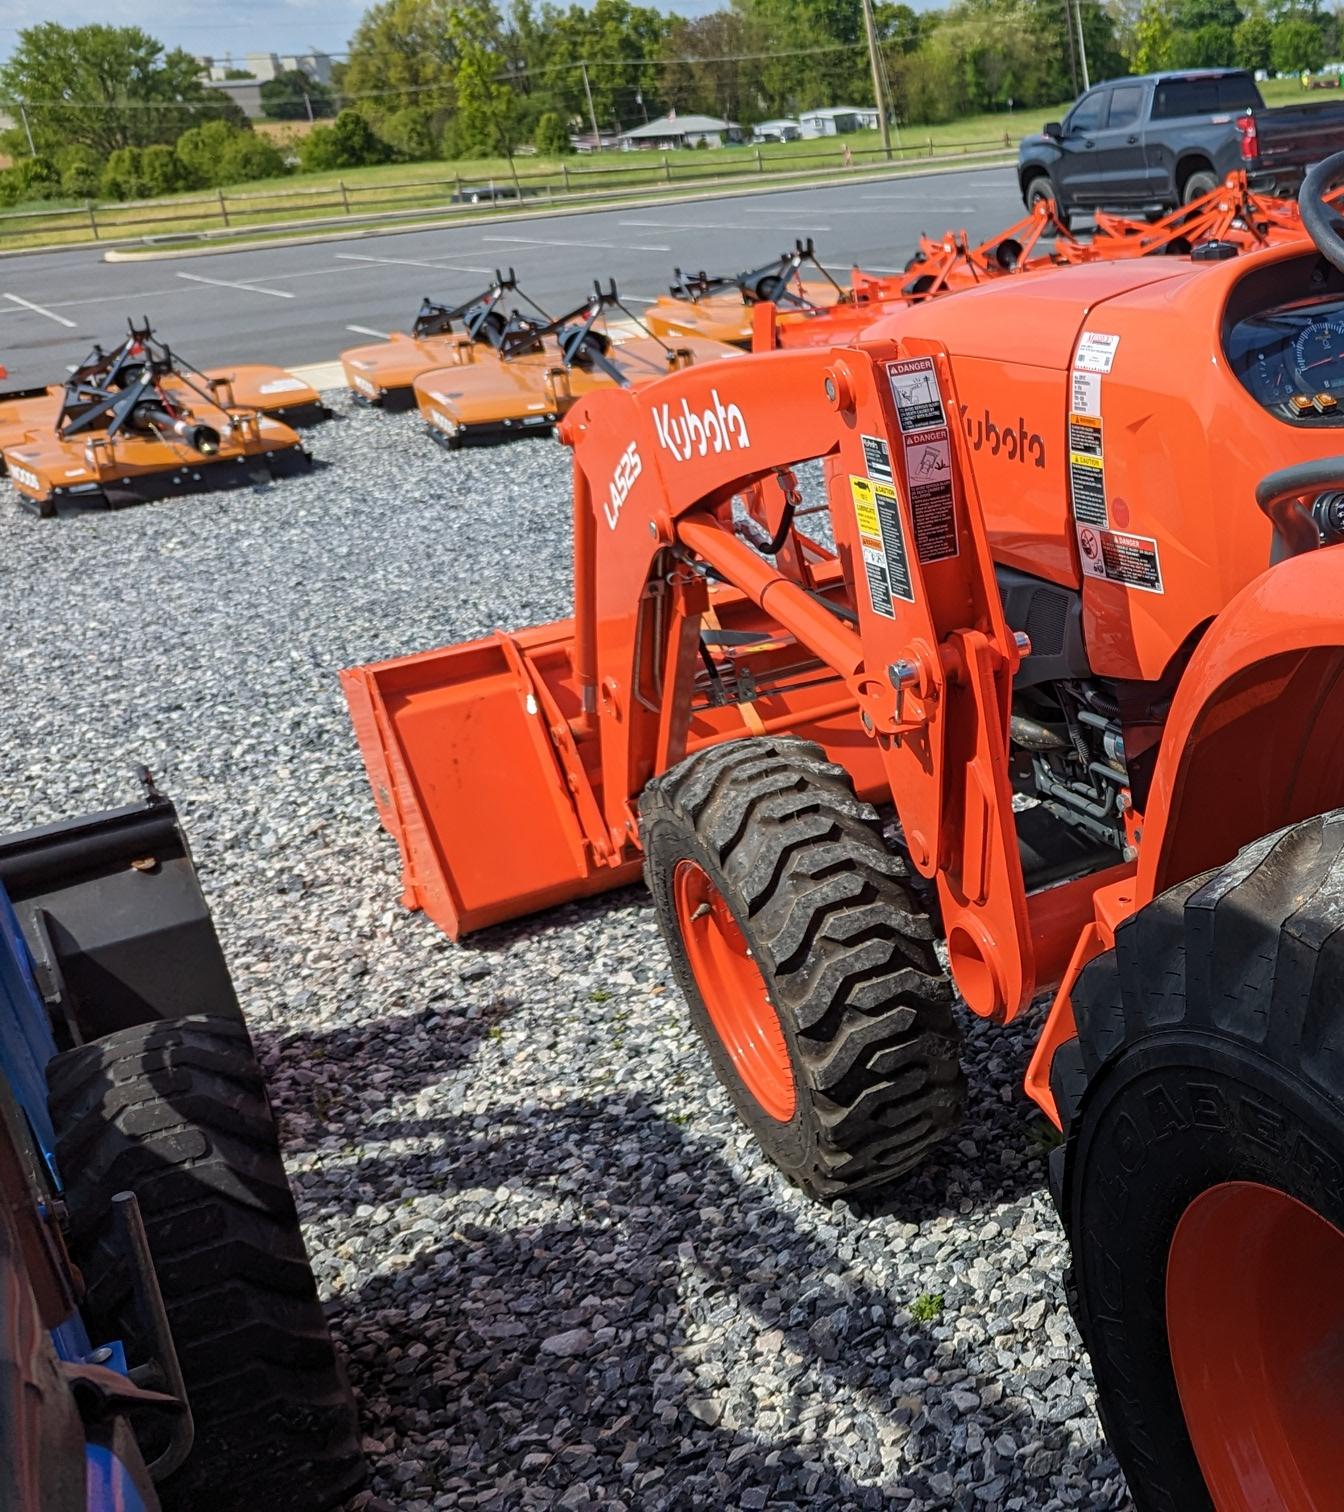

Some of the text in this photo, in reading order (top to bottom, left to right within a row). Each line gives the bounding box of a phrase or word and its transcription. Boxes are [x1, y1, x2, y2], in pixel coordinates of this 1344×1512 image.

[897, 361, 932, 373] DANGER
[650, 389, 750, 462] Kubota
[913, 431, 946, 443] DANGER
[603, 441, 643, 530] LA525
